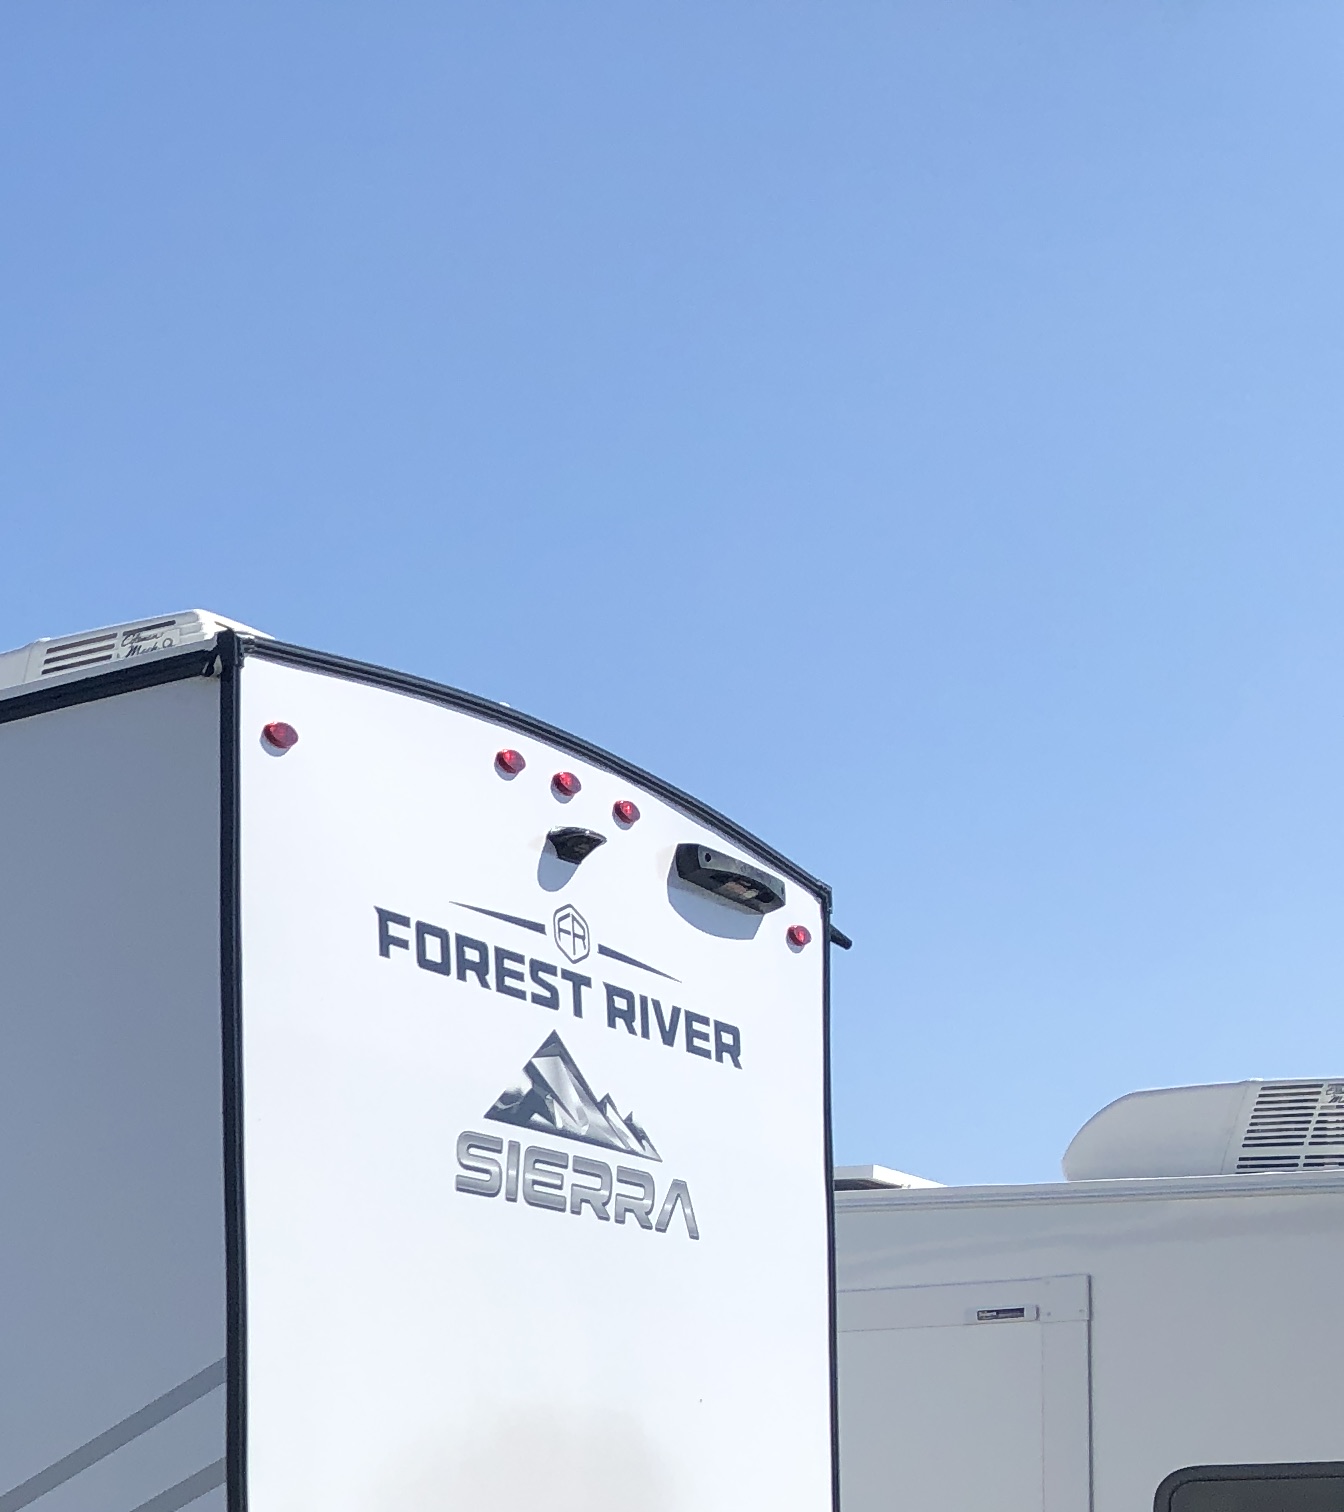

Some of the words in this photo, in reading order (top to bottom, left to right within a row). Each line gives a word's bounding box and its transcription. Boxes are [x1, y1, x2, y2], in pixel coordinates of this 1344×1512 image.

[374, 905, 592, 1019] FOREST
[602, 981, 743, 1070] RIVER
[455, 1130, 700, 1240] SIERRA
